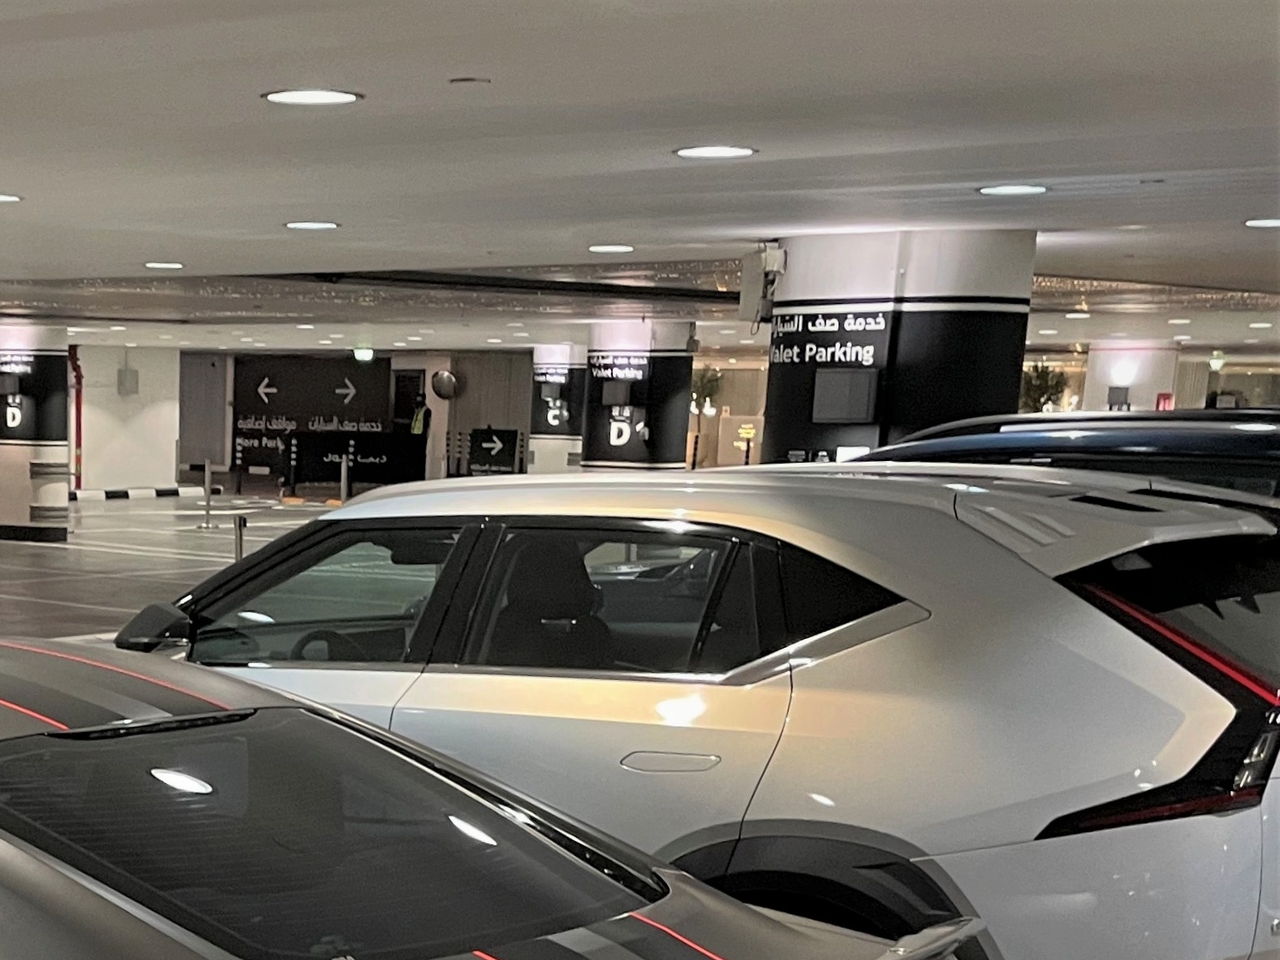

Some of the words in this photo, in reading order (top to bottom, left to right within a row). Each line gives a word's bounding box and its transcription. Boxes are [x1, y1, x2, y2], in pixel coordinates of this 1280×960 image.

[807, 314, 840, 332] صف
[844, 313, 886, 332] خدمة
[805, 342, 875, 366] Parking
[6, 406, 22, 428] D
[547, 408, 560, 426] C
[609, 420, 631, 446] D
